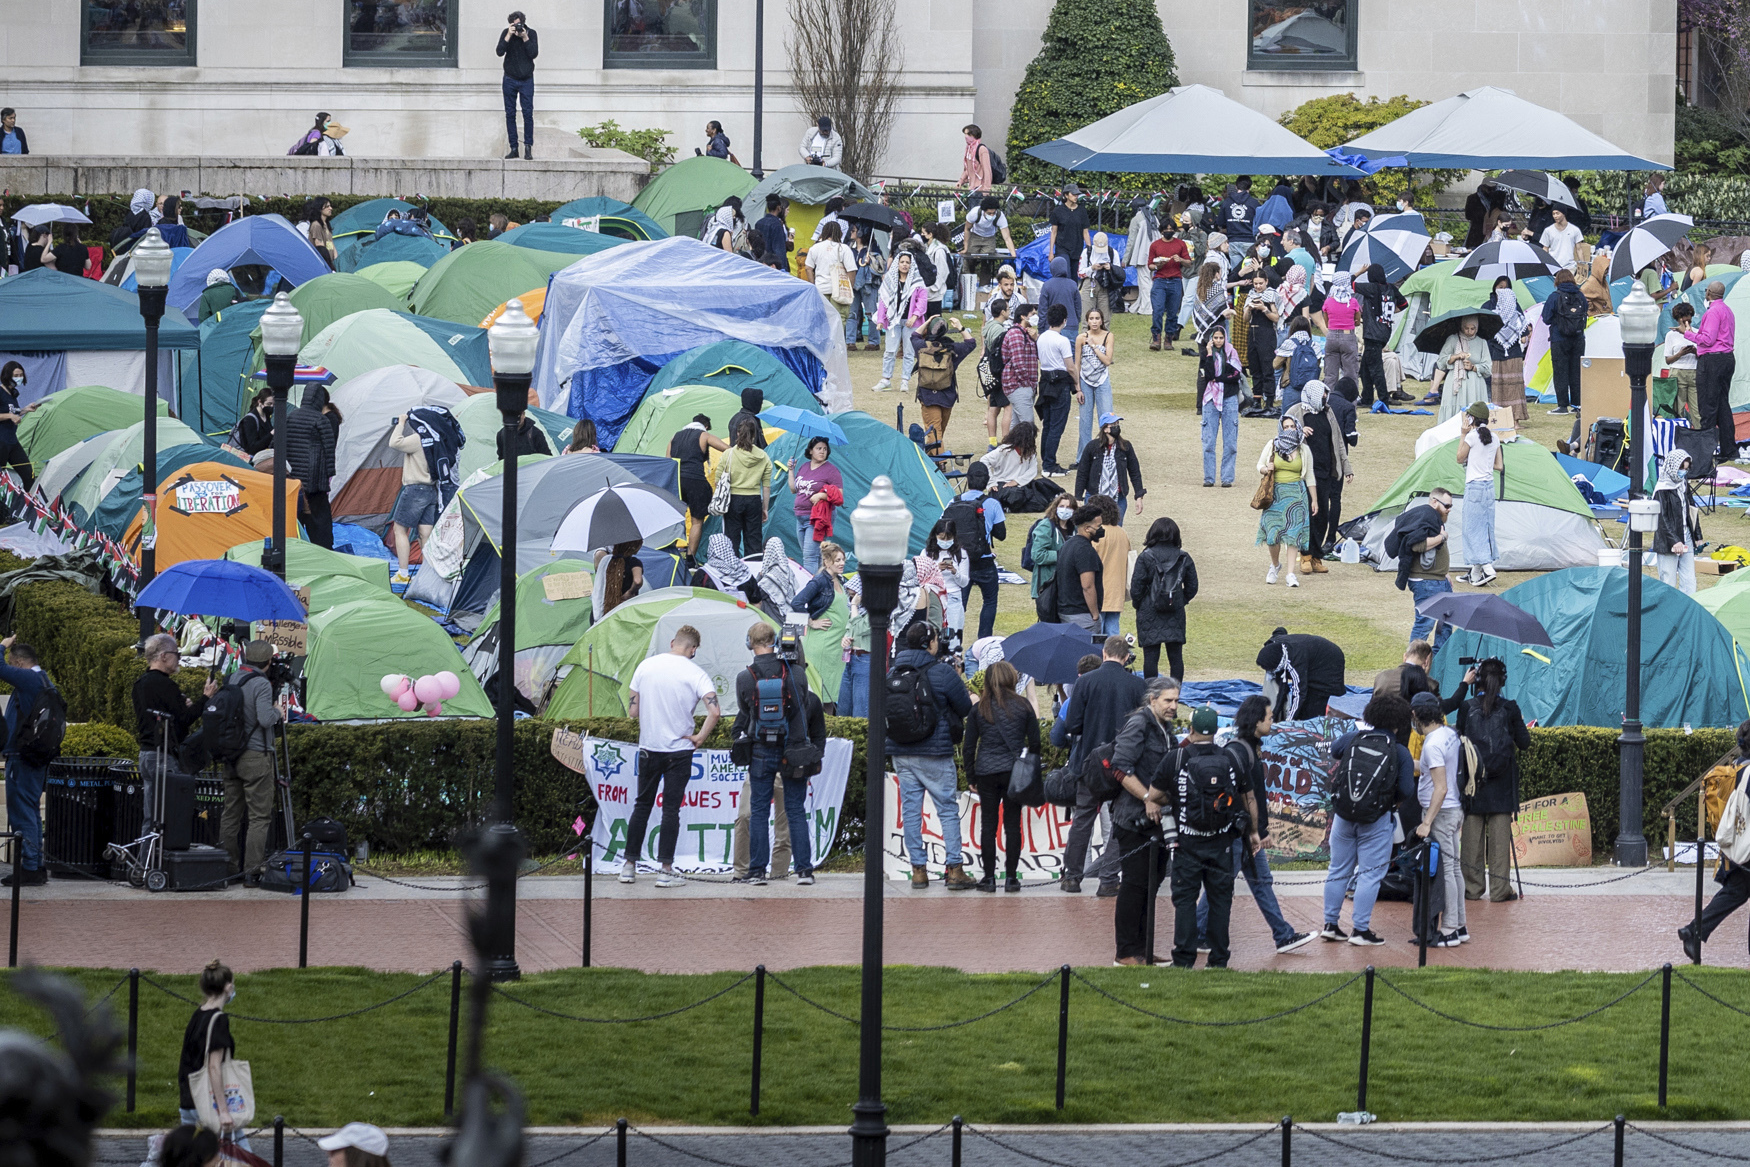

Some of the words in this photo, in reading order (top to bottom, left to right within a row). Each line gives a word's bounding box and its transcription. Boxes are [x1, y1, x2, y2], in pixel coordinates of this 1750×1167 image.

[181, 481, 233, 494] PASSOVER
[177, 493, 241, 512] LIBERATION
[598, 783, 628, 804] FROM
[1534, 798, 1557, 809] FOR
[1517, 809, 1549, 825] FREE
[1522, 819, 1587, 834] PALESTINE
